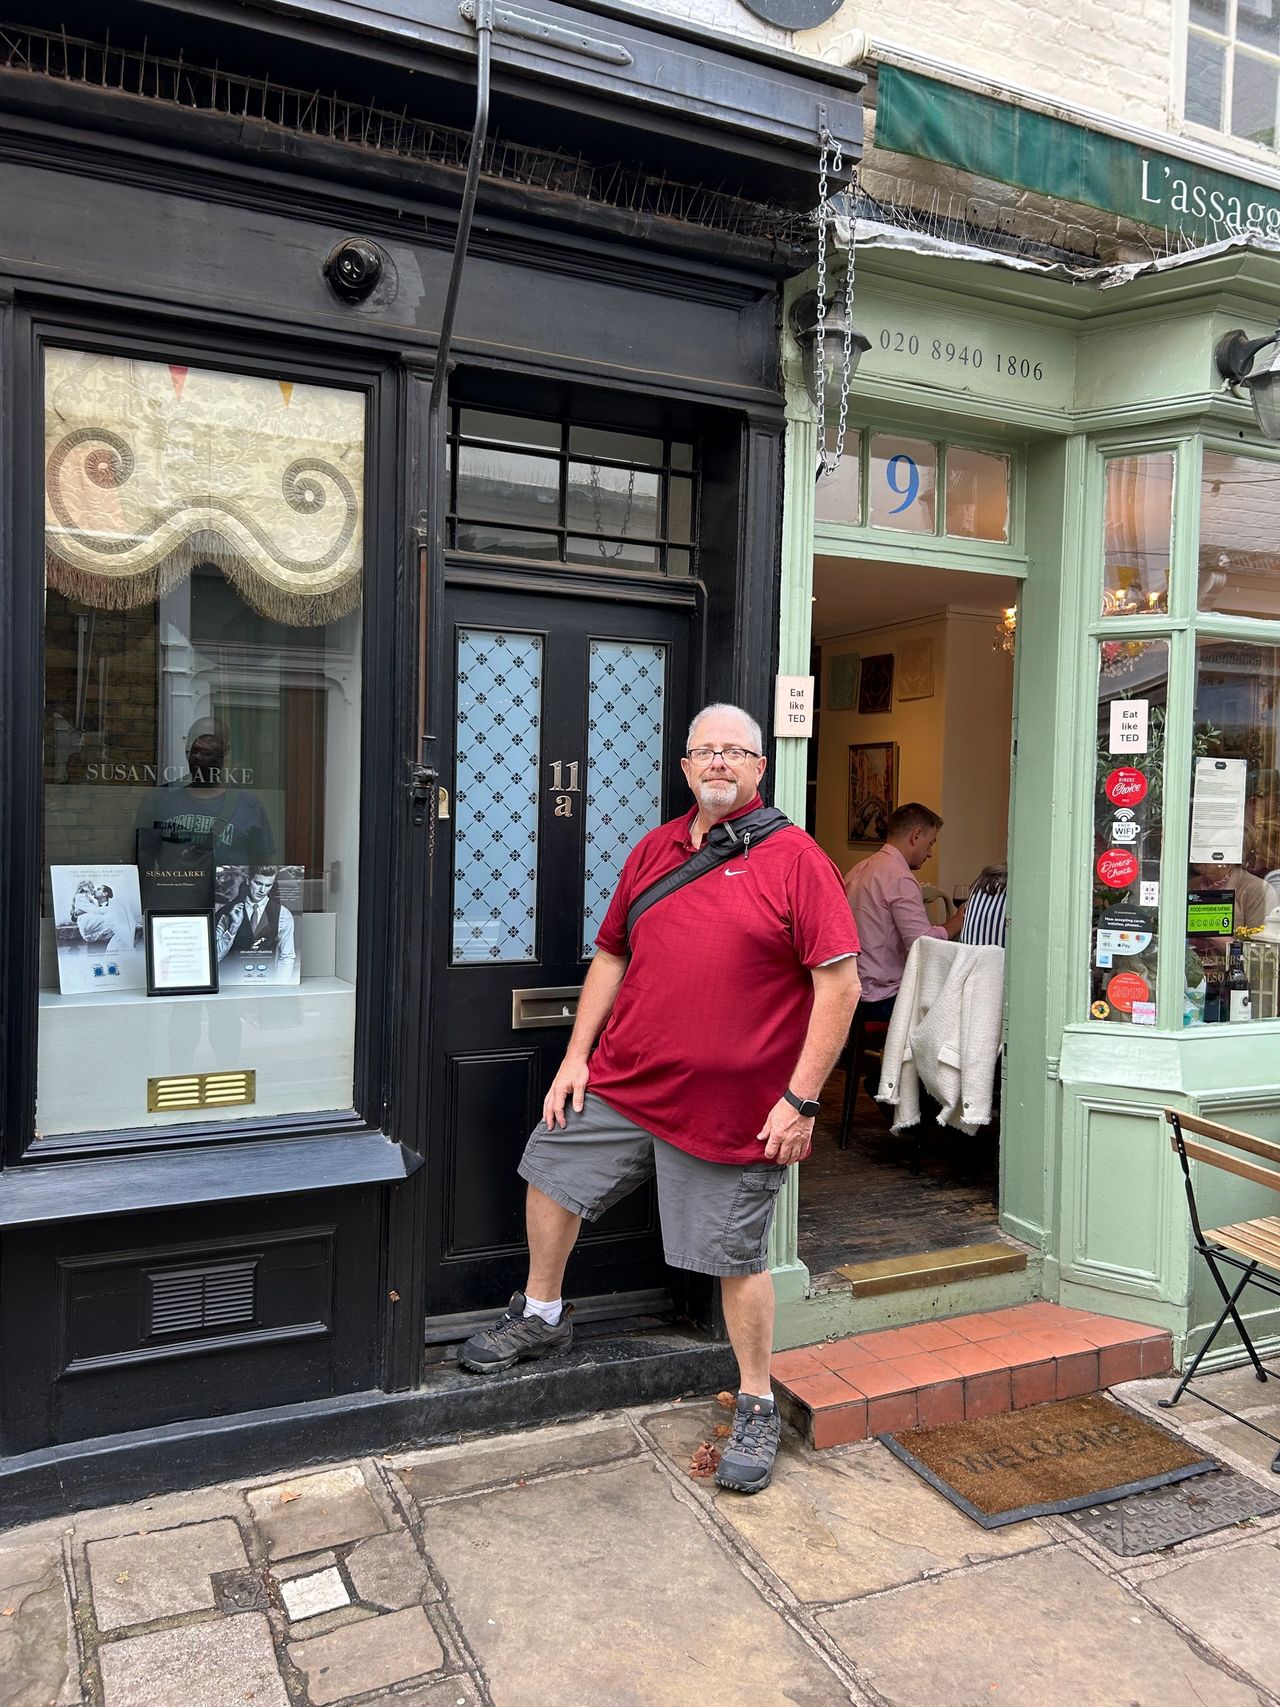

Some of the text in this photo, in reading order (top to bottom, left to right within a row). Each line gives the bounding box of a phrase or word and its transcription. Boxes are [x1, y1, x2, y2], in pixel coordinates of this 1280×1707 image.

[879, 329, 1043, 381] 020 8940 1806
[886, 454, 920, 514] 9
[790, 688, 805, 697] Eat
[789, 701, 805, 710] like
[787, 714, 806, 723] TED
[1122, 710, 1138, 719] Eat
[1121, 722, 1138, 731] like
[1120, 734, 1139, 742] TED
[86, 763, 254, 785] SUSAN CLARKE
[548, 760, 581, 792] 11
[1111, 782, 1142, 797] Choice
[554, 795, 573, 818] a
[1114, 827, 1134, 835] WIFI
[173, 870, 206, 878] CLARKE
[1112, 985, 1144, 999] 2017
